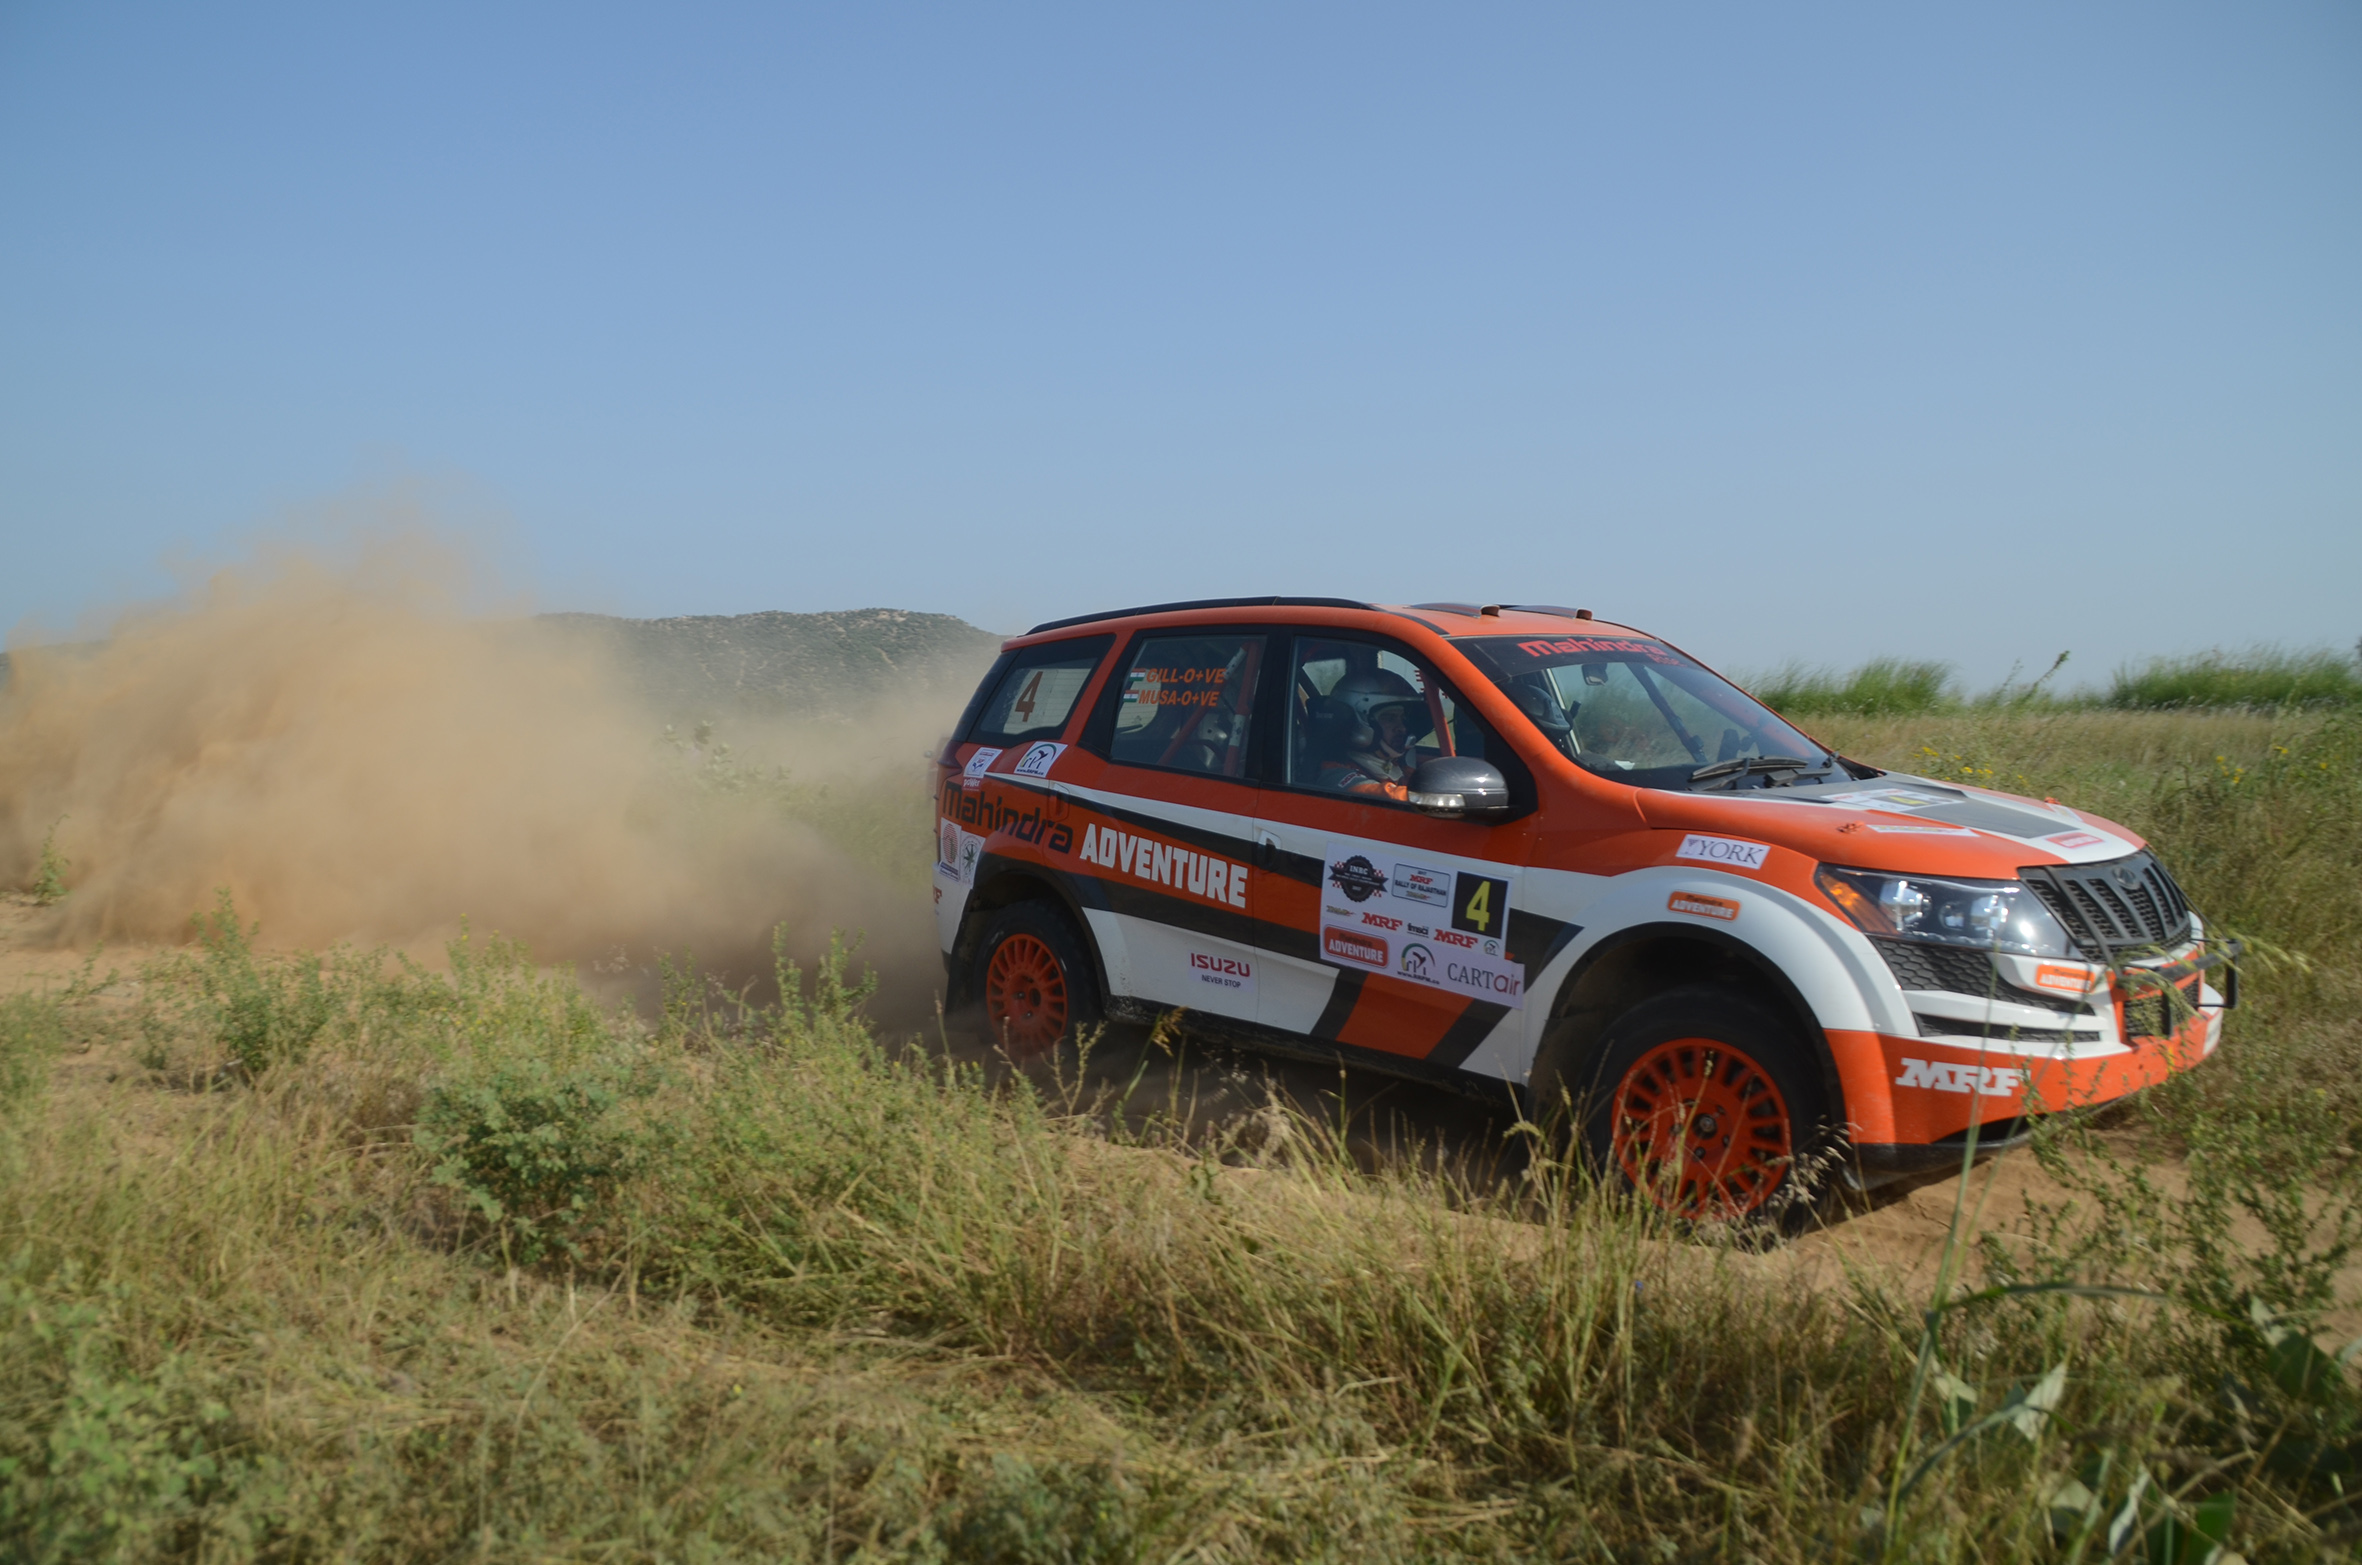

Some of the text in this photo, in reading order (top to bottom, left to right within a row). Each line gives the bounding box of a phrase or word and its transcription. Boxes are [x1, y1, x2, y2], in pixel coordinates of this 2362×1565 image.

[1014, 671, 1043, 722] 4
[1138, 690, 1220, 706] MUSA-O+VE
[1698, 840, 1763, 864] YORK
[1080, 823, 1248, 908] ADVENTURE
[1409, 874, 1434, 885] MRF
[1465, 880, 1491, 931] 4
[1361, 911, 1403, 931] MRF
[1434, 928, 1478, 948] MRF
[1329, 938, 1383, 963] ADVENTURE
[1190, 952, 1250, 977] ISUZU
[1201, 974, 1241, 988] NEVER STOP
[1895, 1057, 2031, 1097] MRF
